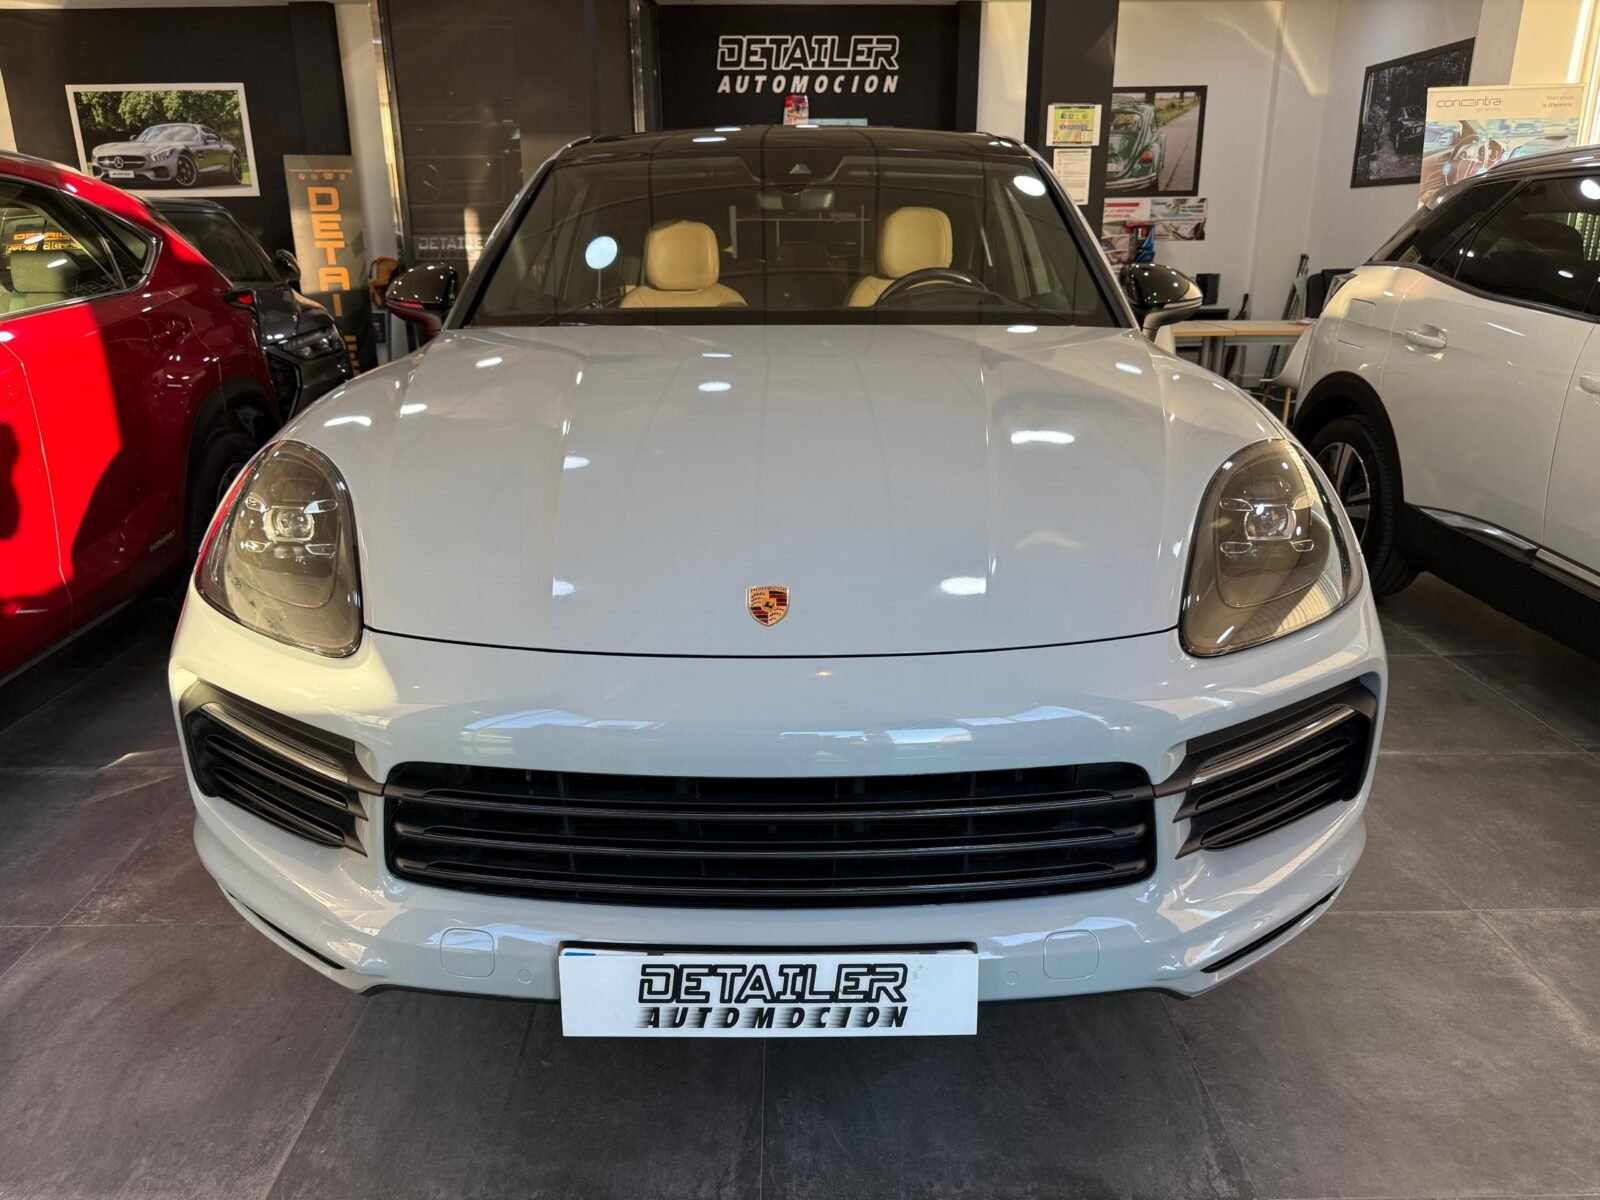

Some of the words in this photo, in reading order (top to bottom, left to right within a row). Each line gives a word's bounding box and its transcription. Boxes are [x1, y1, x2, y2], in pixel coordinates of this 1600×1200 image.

[717, 35, 900, 71] DETAILER
[716, 75, 899, 93] AUTOMOCION
[1436, 96, 1502, 108] concentra
[418, 236, 486, 250] DETAILE
[638, 963, 909, 1004] DETAILER
[636, 1006, 909, 1029] AUTOMOCION
